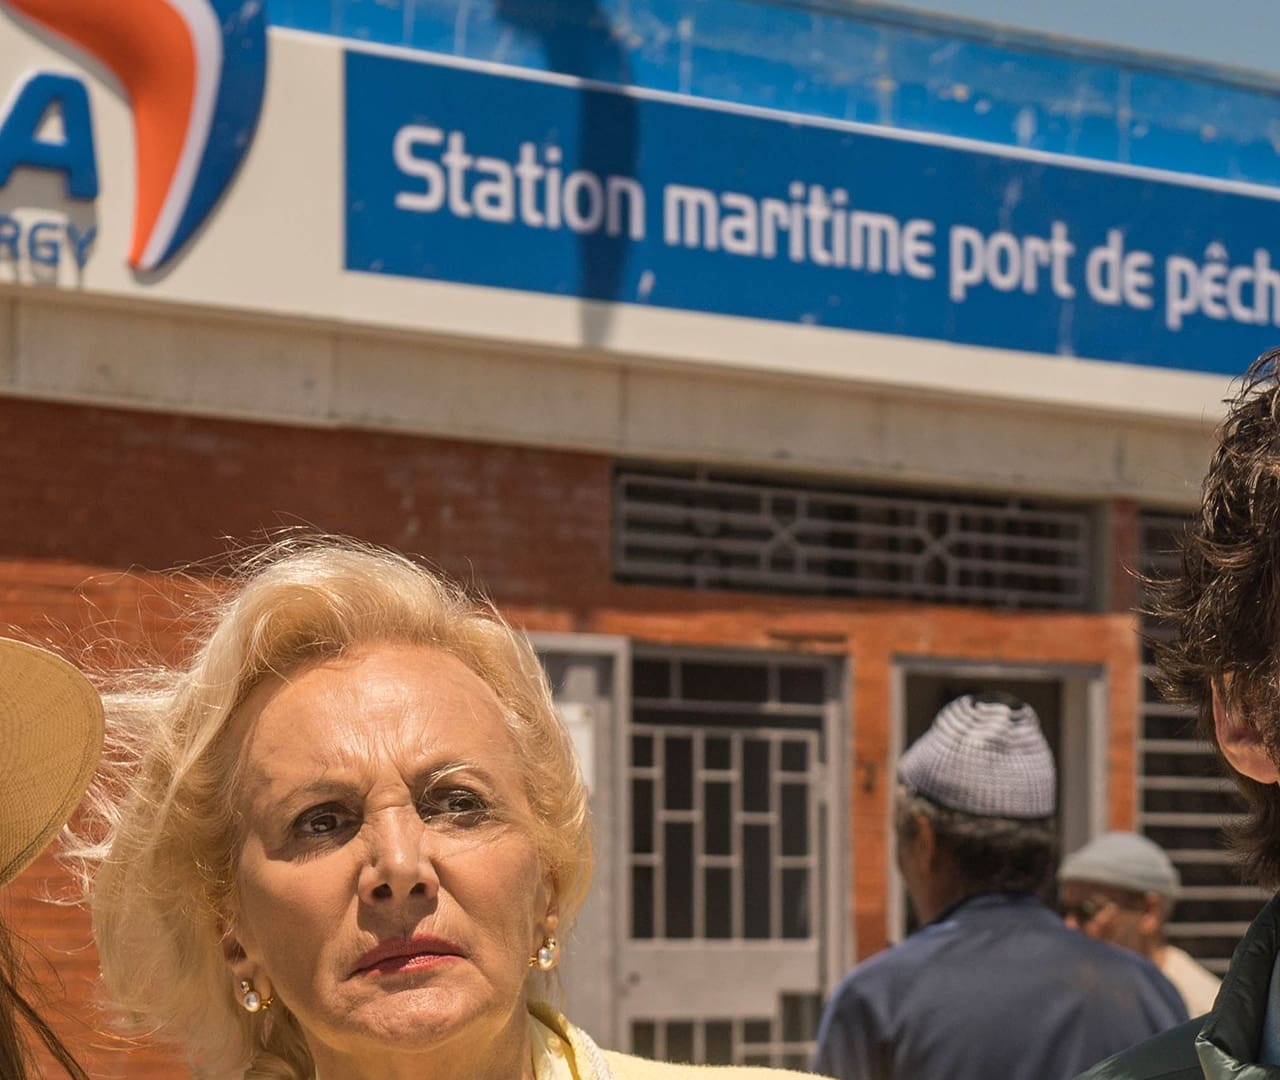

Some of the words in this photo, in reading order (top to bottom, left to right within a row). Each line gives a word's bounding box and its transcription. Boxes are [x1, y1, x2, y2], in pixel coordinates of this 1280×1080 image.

[392, 124, 646, 241] Station
[663, 181, 936, 280] maritime
[949, 221, 1075, 302] port
[1085, 229, 1155, 309] de
